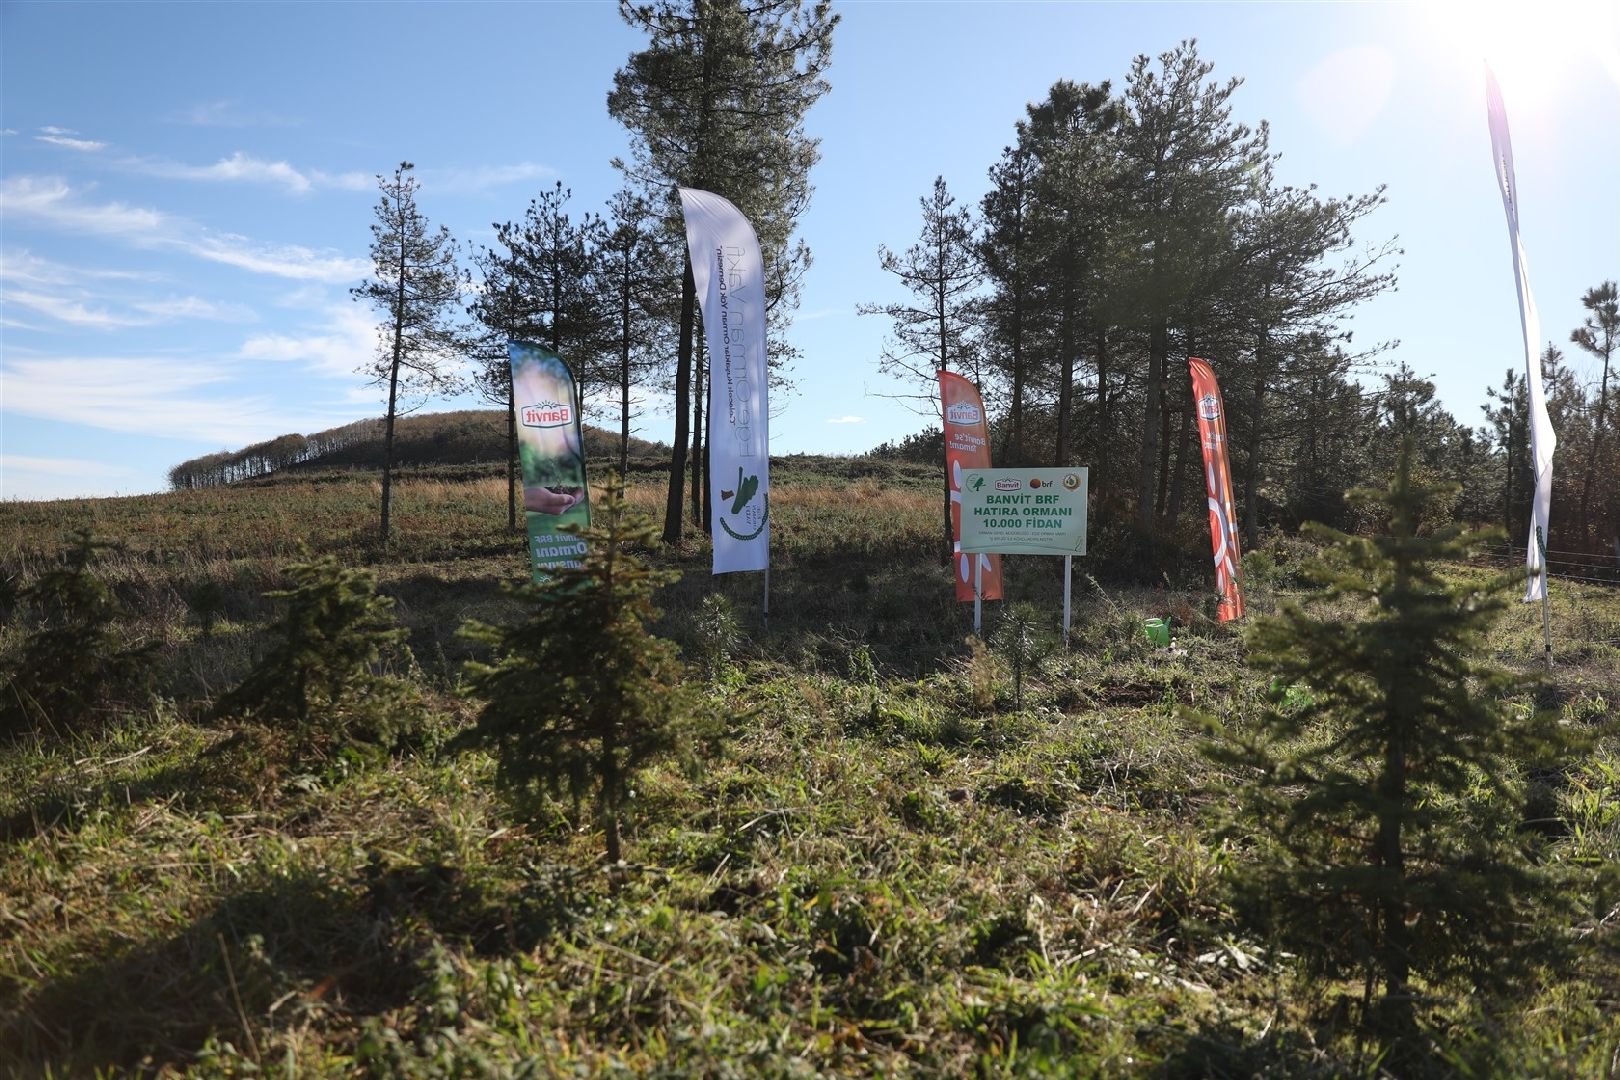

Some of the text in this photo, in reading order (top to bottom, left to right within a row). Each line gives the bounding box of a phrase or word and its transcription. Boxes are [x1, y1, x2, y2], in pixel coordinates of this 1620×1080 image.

[997, 481, 1019, 489] Banvit
[1041, 480, 1053, 488] brf
[986, 493, 1060, 505] BANVİT BRF
[974, 507, 1072, 517] HATIRA ORMANI
[983, 517, 1062, 528] 10.000 FİDAN
